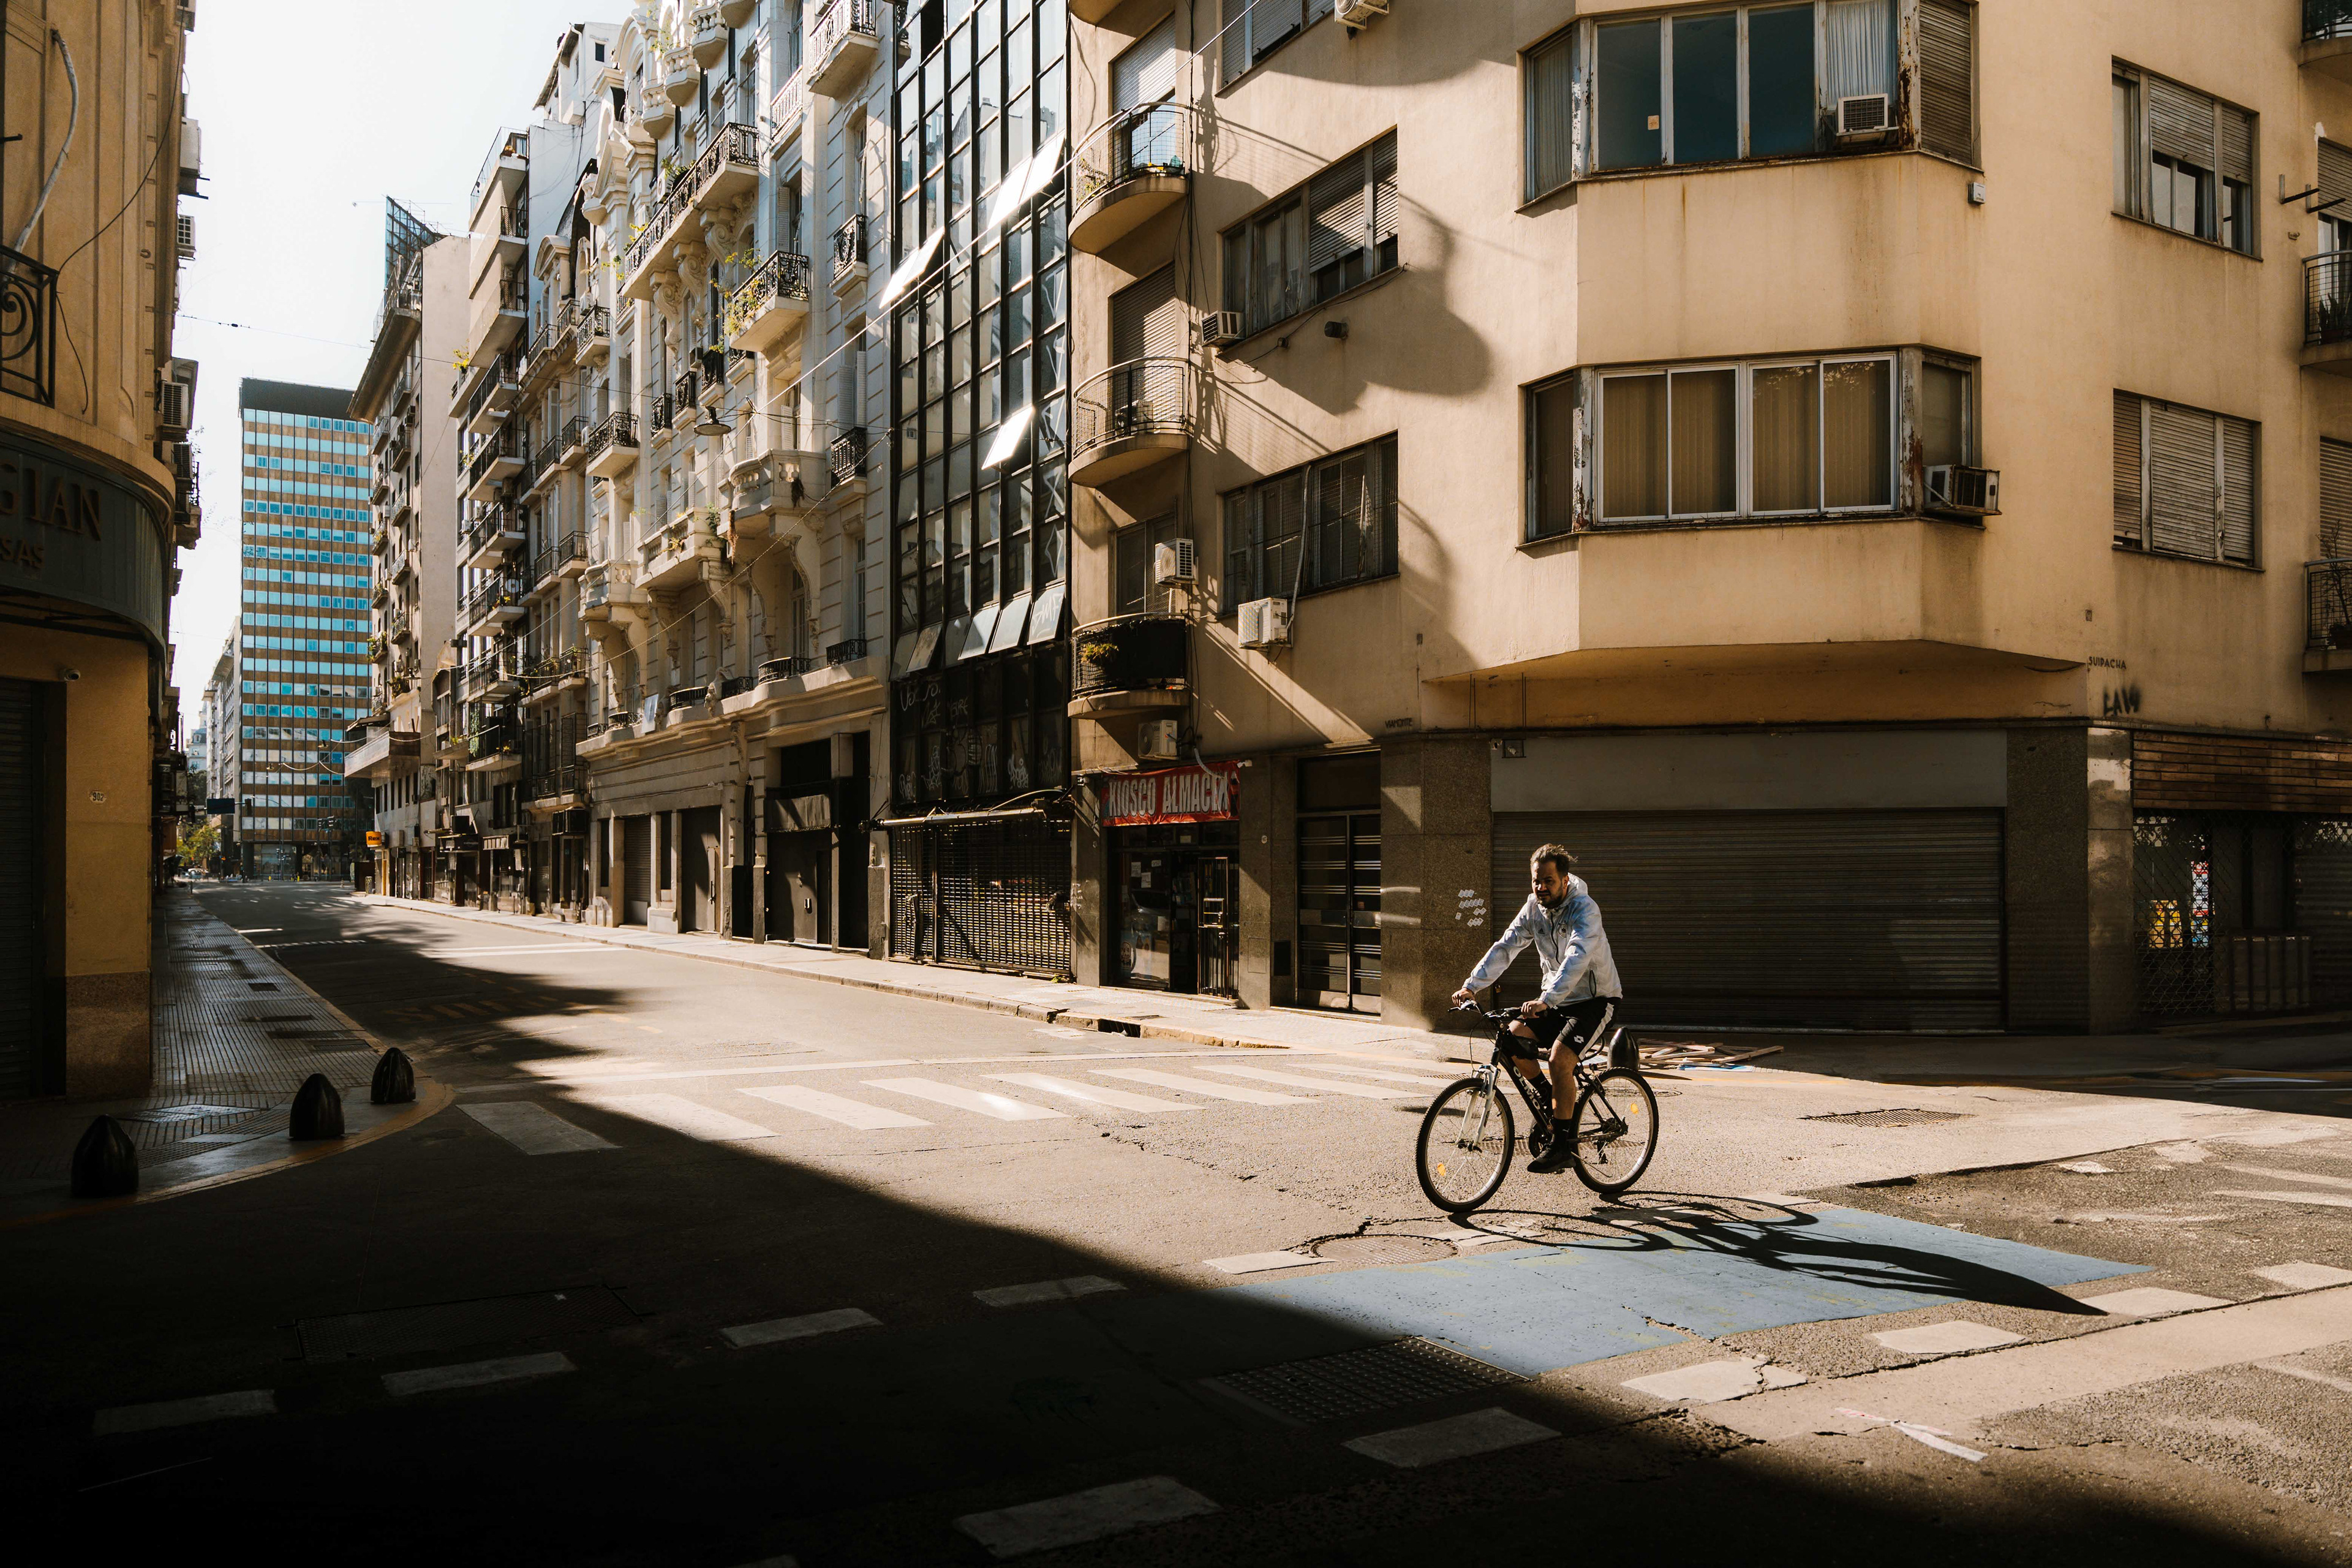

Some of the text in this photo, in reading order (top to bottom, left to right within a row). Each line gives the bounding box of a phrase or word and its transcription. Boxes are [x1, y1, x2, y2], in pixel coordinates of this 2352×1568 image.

[2089, 656, 2127, 669] SUIPACHA
[92, 792, 104, 801] 902
[1109, 777, 1156, 817] KIOSCO
[1513, 1066, 1540, 1110] OLMO
